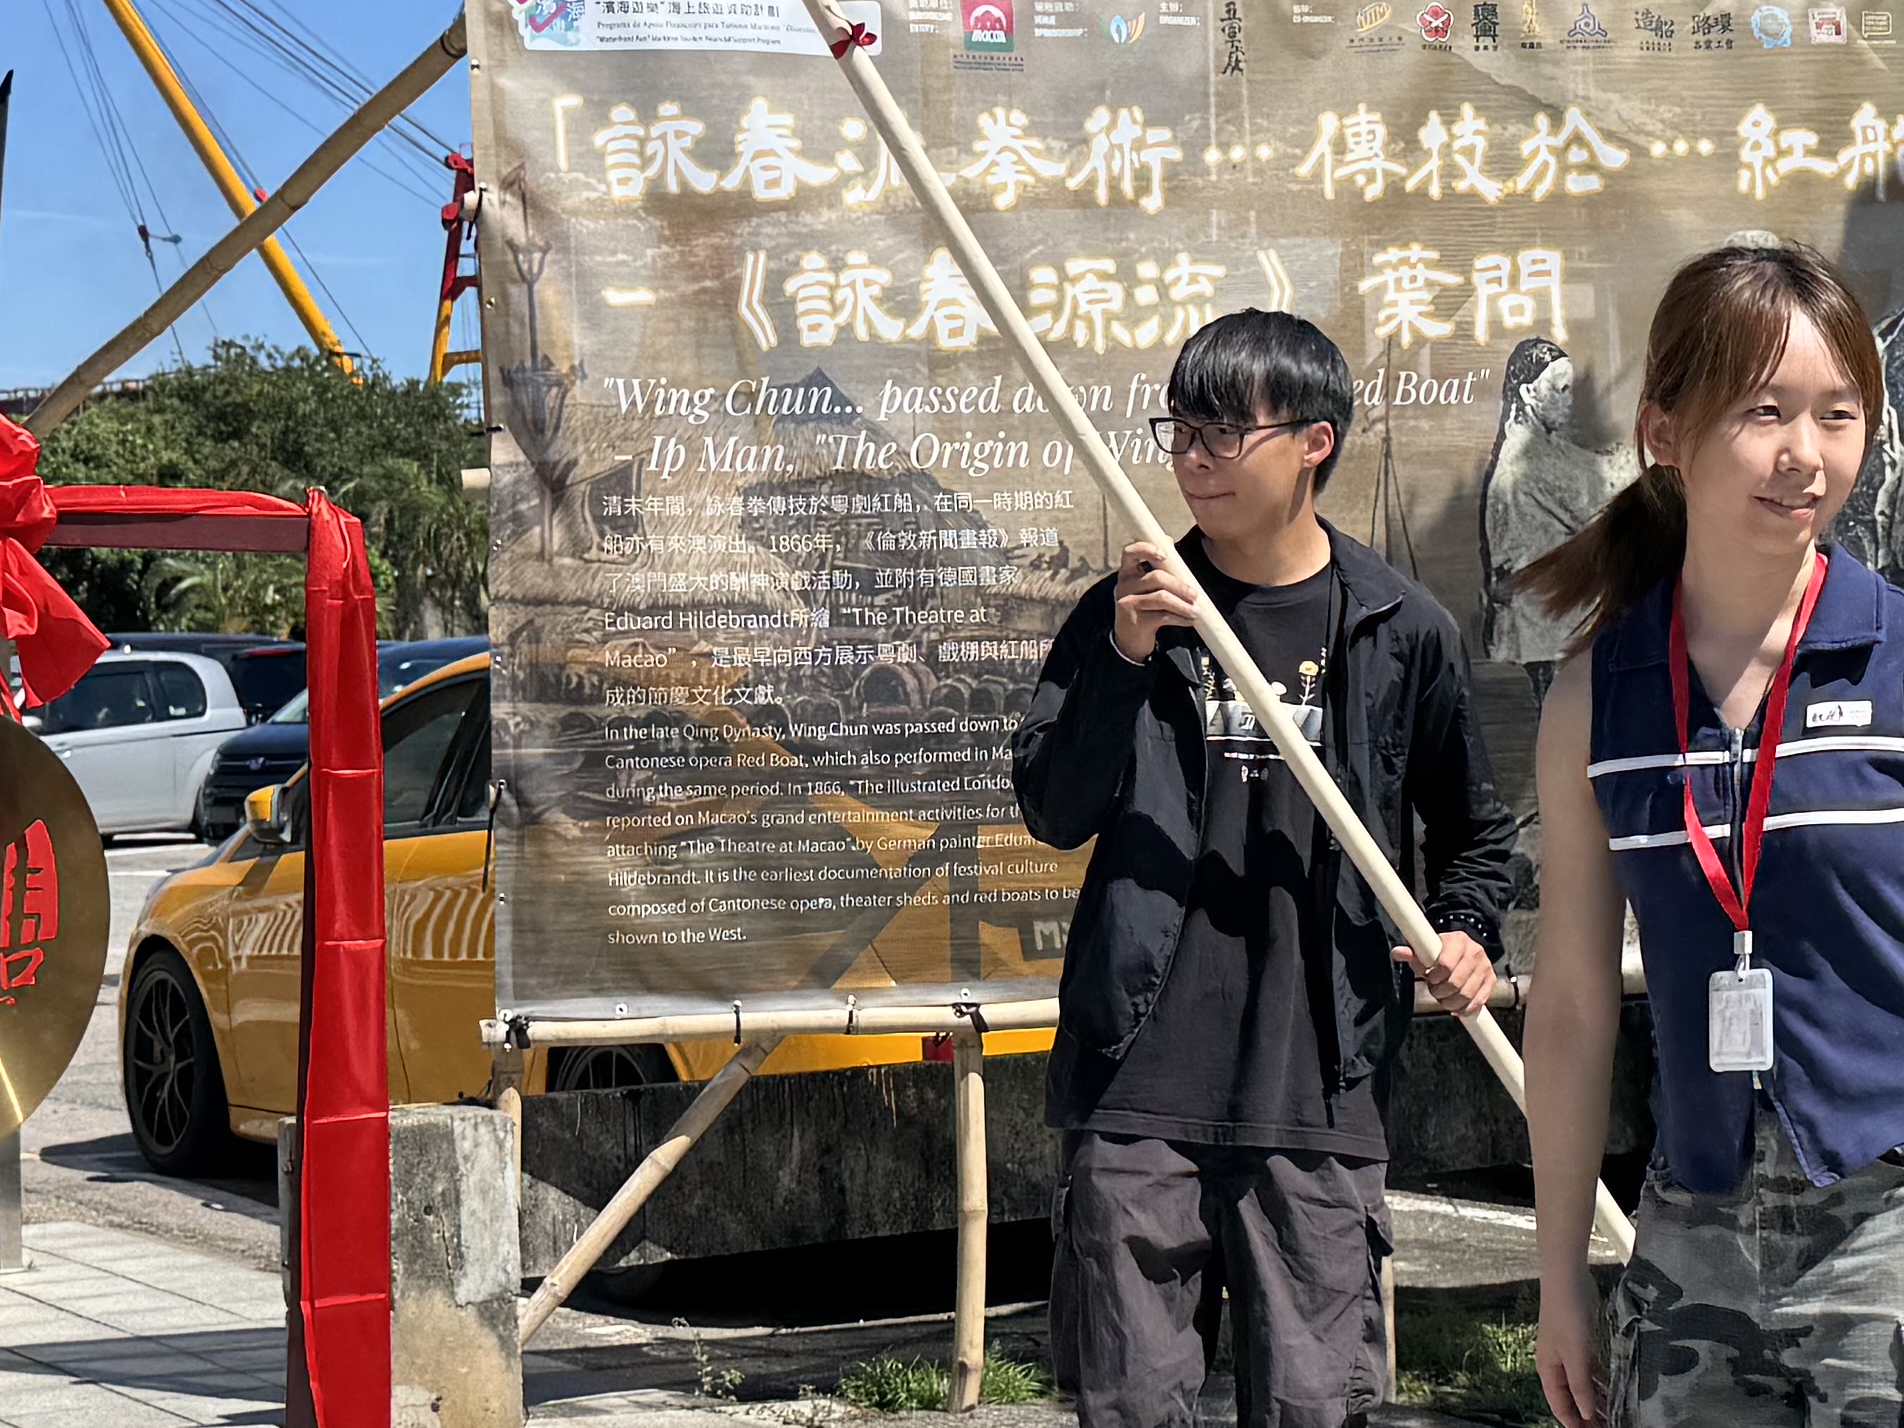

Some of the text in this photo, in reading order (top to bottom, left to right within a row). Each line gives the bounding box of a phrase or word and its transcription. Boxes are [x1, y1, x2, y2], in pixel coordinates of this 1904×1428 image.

[1359, 243, 1568, 348] 葉問
[724, 375, 864, 416] Chun...
[876, 374, 1003, 422] passed
[645, 435, 687, 480] Ip
[697, 435, 796, 477] Man,
[909, 430, 1030, 477] Origin
[604, 610, 673, 631] Eduard
[892, 606, 965, 625] Theatre
[969, 606, 987, 623] at
[605, 716, 1019, 743] In the late Qing Dynasty, Wing Chun was passed down to
[605, 754, 686, 770] Cantonese
[689, 755, 733, 771] opera
[737, 752, 766, 769] Red
[769, 752, 809, 769] Boat,
[812, 749, 857, 767] which
[860, 749, 891, 766] also
[894, 746, 971, 768] performed
[975, 746, 989, 762] in
[605, 776, 961, 803] during the same period. In 1866, Illustrated
[605, 811, 672, 831] reported
[675, 813, 694, 826] on
[761, 809, 805, 827] grand
[808, 807, 914, 825] entertainment
[917, 804, 984, 822] activities
[985, 803, 1005, 819] for
[607, 832, 991, 860] attaching Theatre at by German painter
[608, 858, 1059, 887] Hildebrandt. It is the earliest documentation of festival culture
[608, 898, 686, 918] composed
[690, 897, 706, 914] of
[708, 896, 787, 913] Cantonese
[790, 896, 837, 914] opera,
[839, 891, 894, 909] theater
[896, 890, 939, 908] sheds
[942, 889, 970, 905] and
[973, 889, 997, 903] red
[1001, 887, 1041, 903] boats
[1044, 885, 1059, 900] to
[607, 926, 748, 945] shown to the West.
